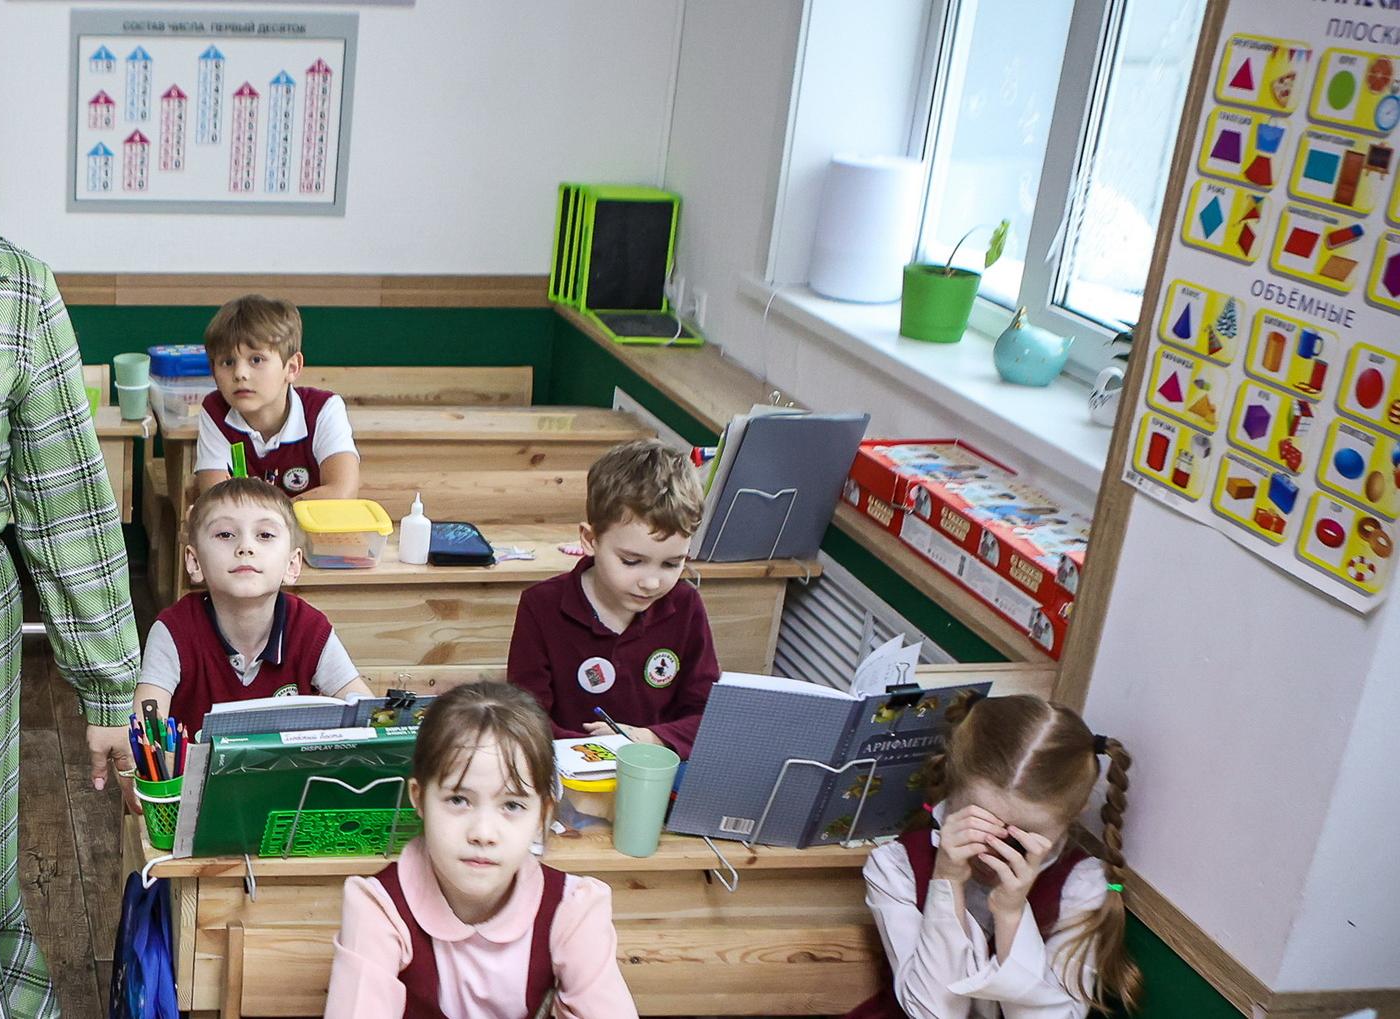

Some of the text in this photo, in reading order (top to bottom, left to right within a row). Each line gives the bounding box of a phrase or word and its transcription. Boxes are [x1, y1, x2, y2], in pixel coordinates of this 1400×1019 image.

[1250, 279, 1356, 329] ОБЪЁМНЫЕ
[917, 707, 927, 718] 2
[300, 744, 333, 752] DISPLAY
[863, 735, 945, 754] АРИФМЕТИ
